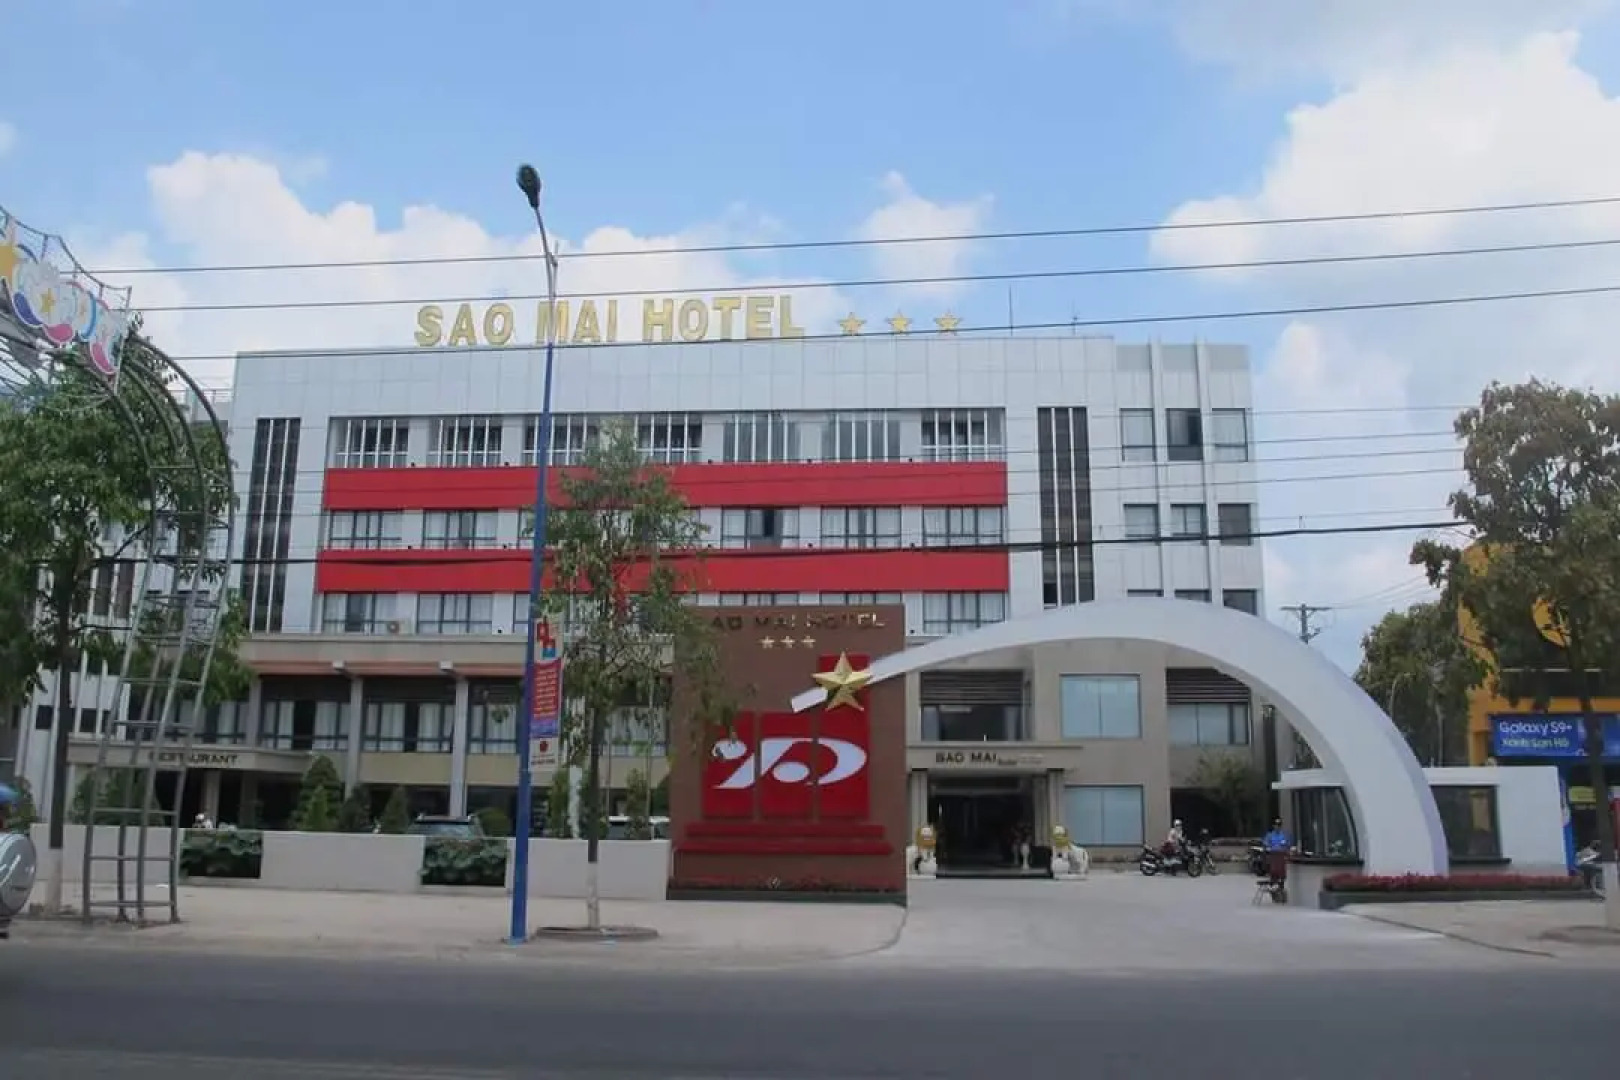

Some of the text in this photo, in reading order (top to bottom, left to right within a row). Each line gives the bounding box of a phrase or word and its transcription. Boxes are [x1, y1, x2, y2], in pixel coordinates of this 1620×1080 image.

[414, 295, 806, 347] SAO MAI HOTEL
[708, 613, 743, 631] AO
[1499, 721, 1548, 736] Galaxy
[149, 751, 238, 764] ESTURANT
